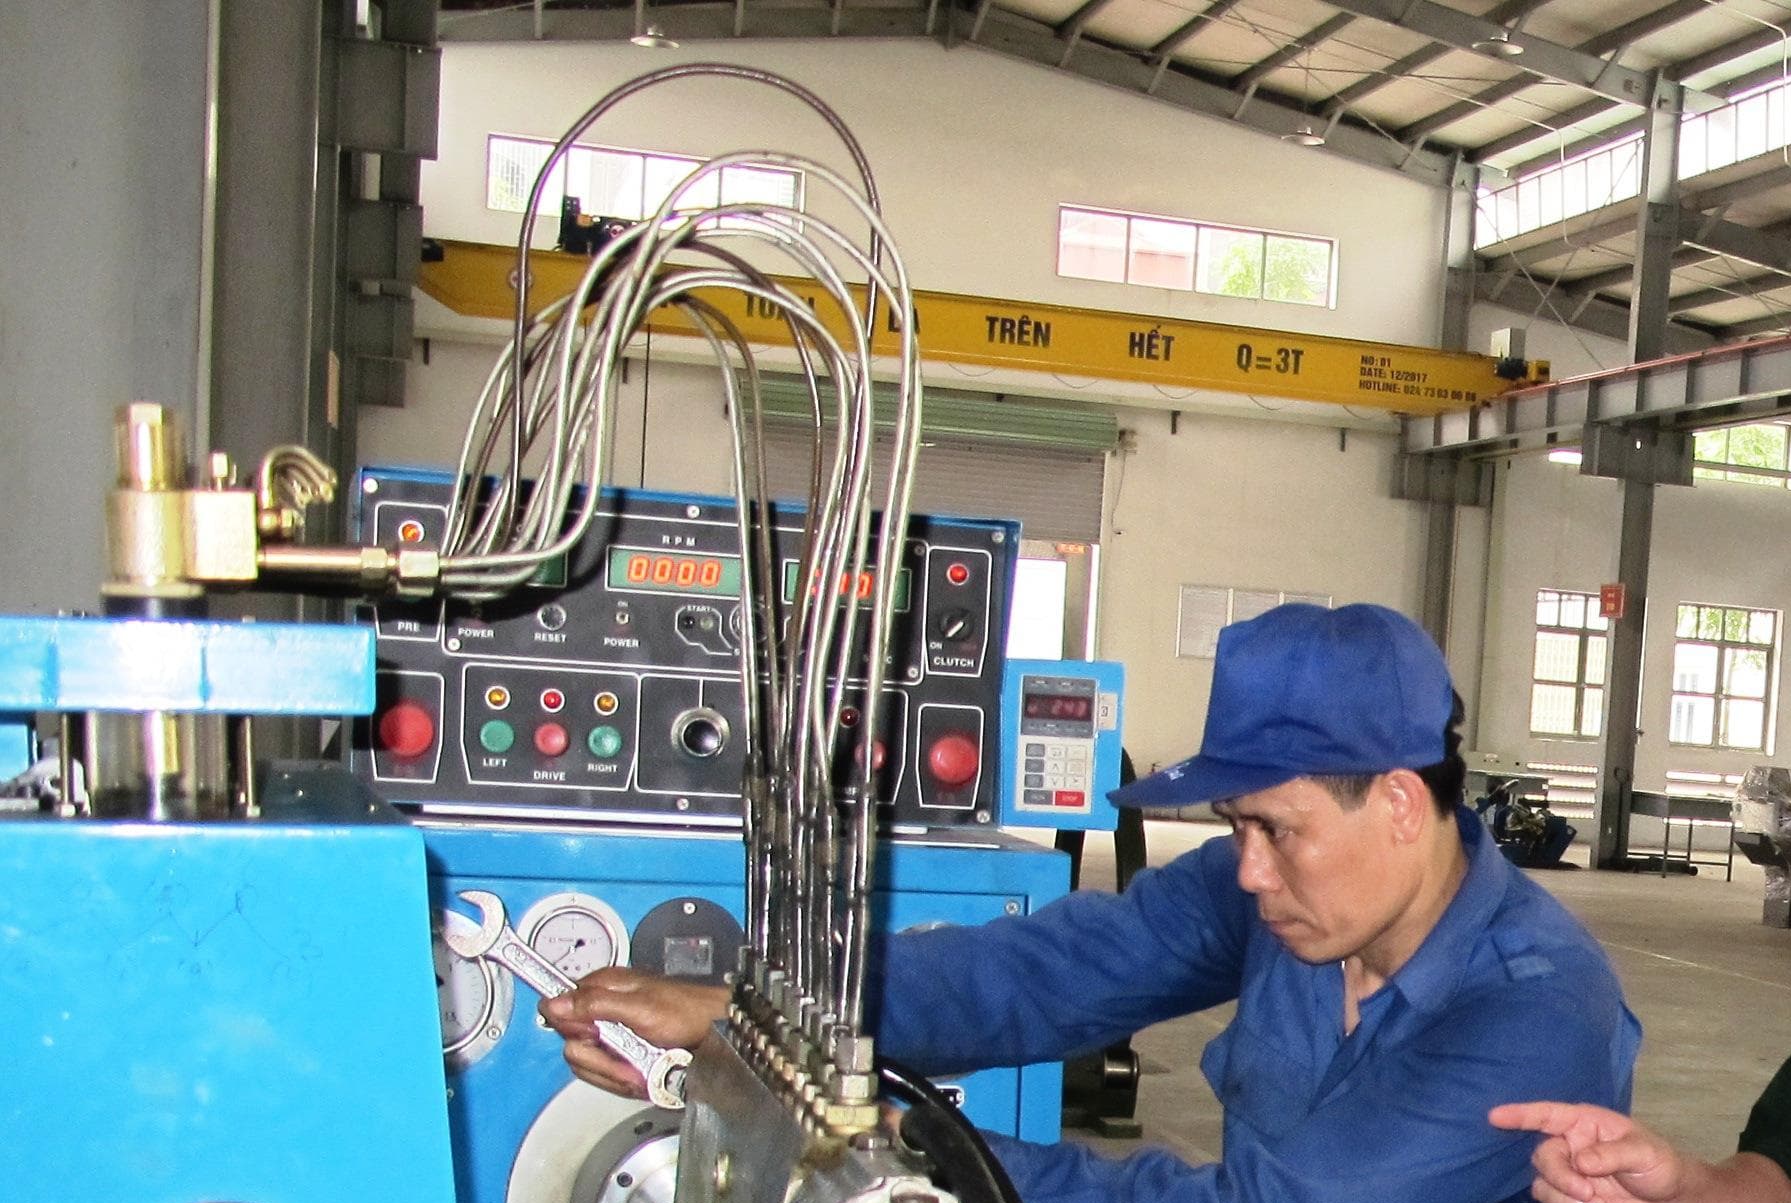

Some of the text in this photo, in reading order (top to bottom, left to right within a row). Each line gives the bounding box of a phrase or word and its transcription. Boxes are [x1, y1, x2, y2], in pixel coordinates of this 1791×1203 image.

[985, 315, 1051, 348] TRÊN
[1128, 325, 1175, 361] HẾT
[1236, 343, 1304, 375] Q=3T
[1360, 367, 1387, 379] DATE:
[1359, 380, 1401, 394] HOTLINE:
[628, 555, 722, 588] 0000
[686, 604, 711, 612] START
[458, 627, 495, 638] POWER
[534, 633, 567, 643] RESET
[603, 637, 640, 649] POWER
[929, 642, 943, 650] ON
[933, 656, 975, 668] CLUTCH
[483, 758, 508, 767] LEFT
[587, 763, 618, 773] RIGHT
[533, 770, 566, 782] DRIVE
